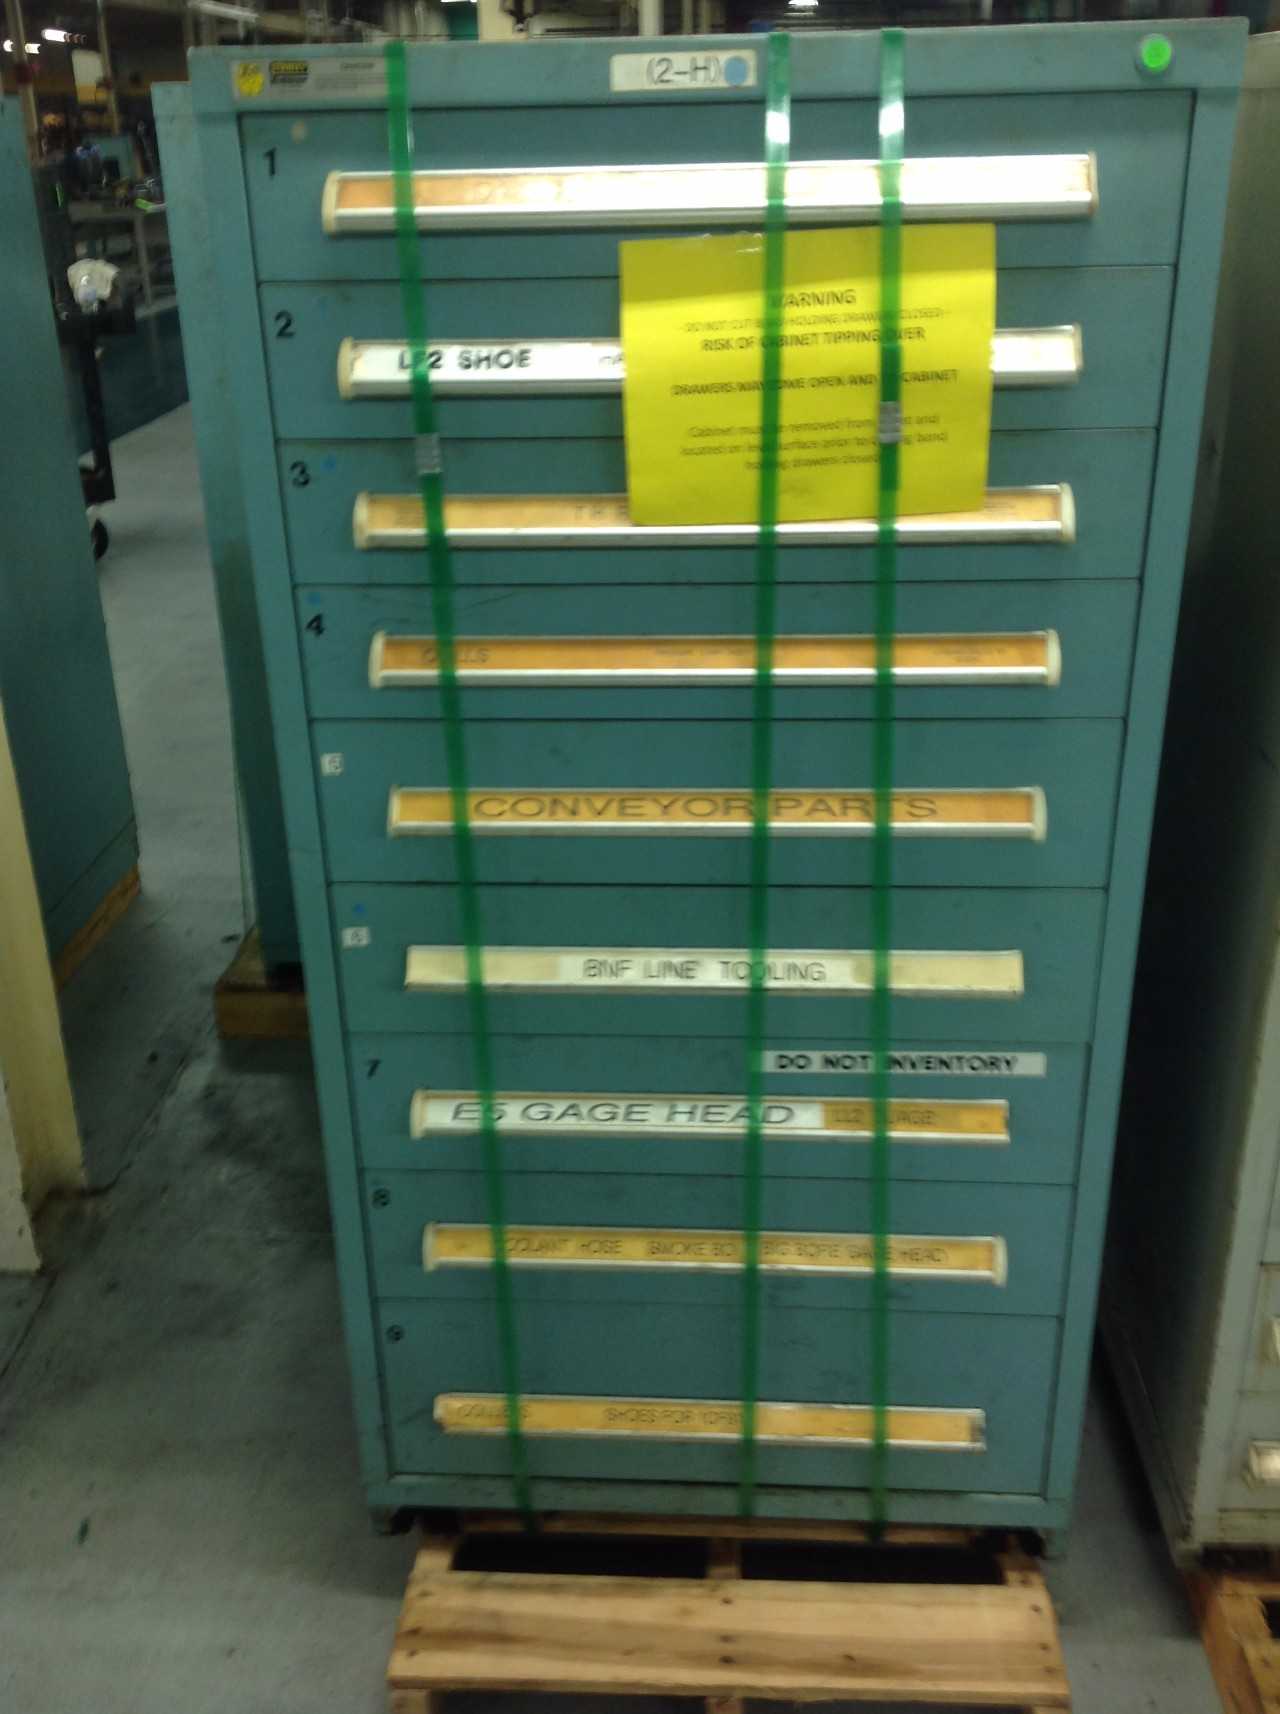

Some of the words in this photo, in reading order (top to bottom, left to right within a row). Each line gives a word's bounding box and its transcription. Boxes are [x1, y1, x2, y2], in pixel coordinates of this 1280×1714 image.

[263, 148, 277, 176] 1
[274, 311, 295, 338] 2
[458, 349, 532, 370] SHOE
[290, 461, 311, 487] 3
[306, 613, 325, 637] 4
[473, 796, 754, 818] CONVEYOR
[645, 959, 700, 980] LINE
[366, 1058, 381, 1079] 7
[775, 1054, 812, 1071] DO
[820, 1054, 873, 1071] NOT
[882, 1054, 1019, 1072] NVENTORY
[520, 1101, 655, 1123] GAGE
